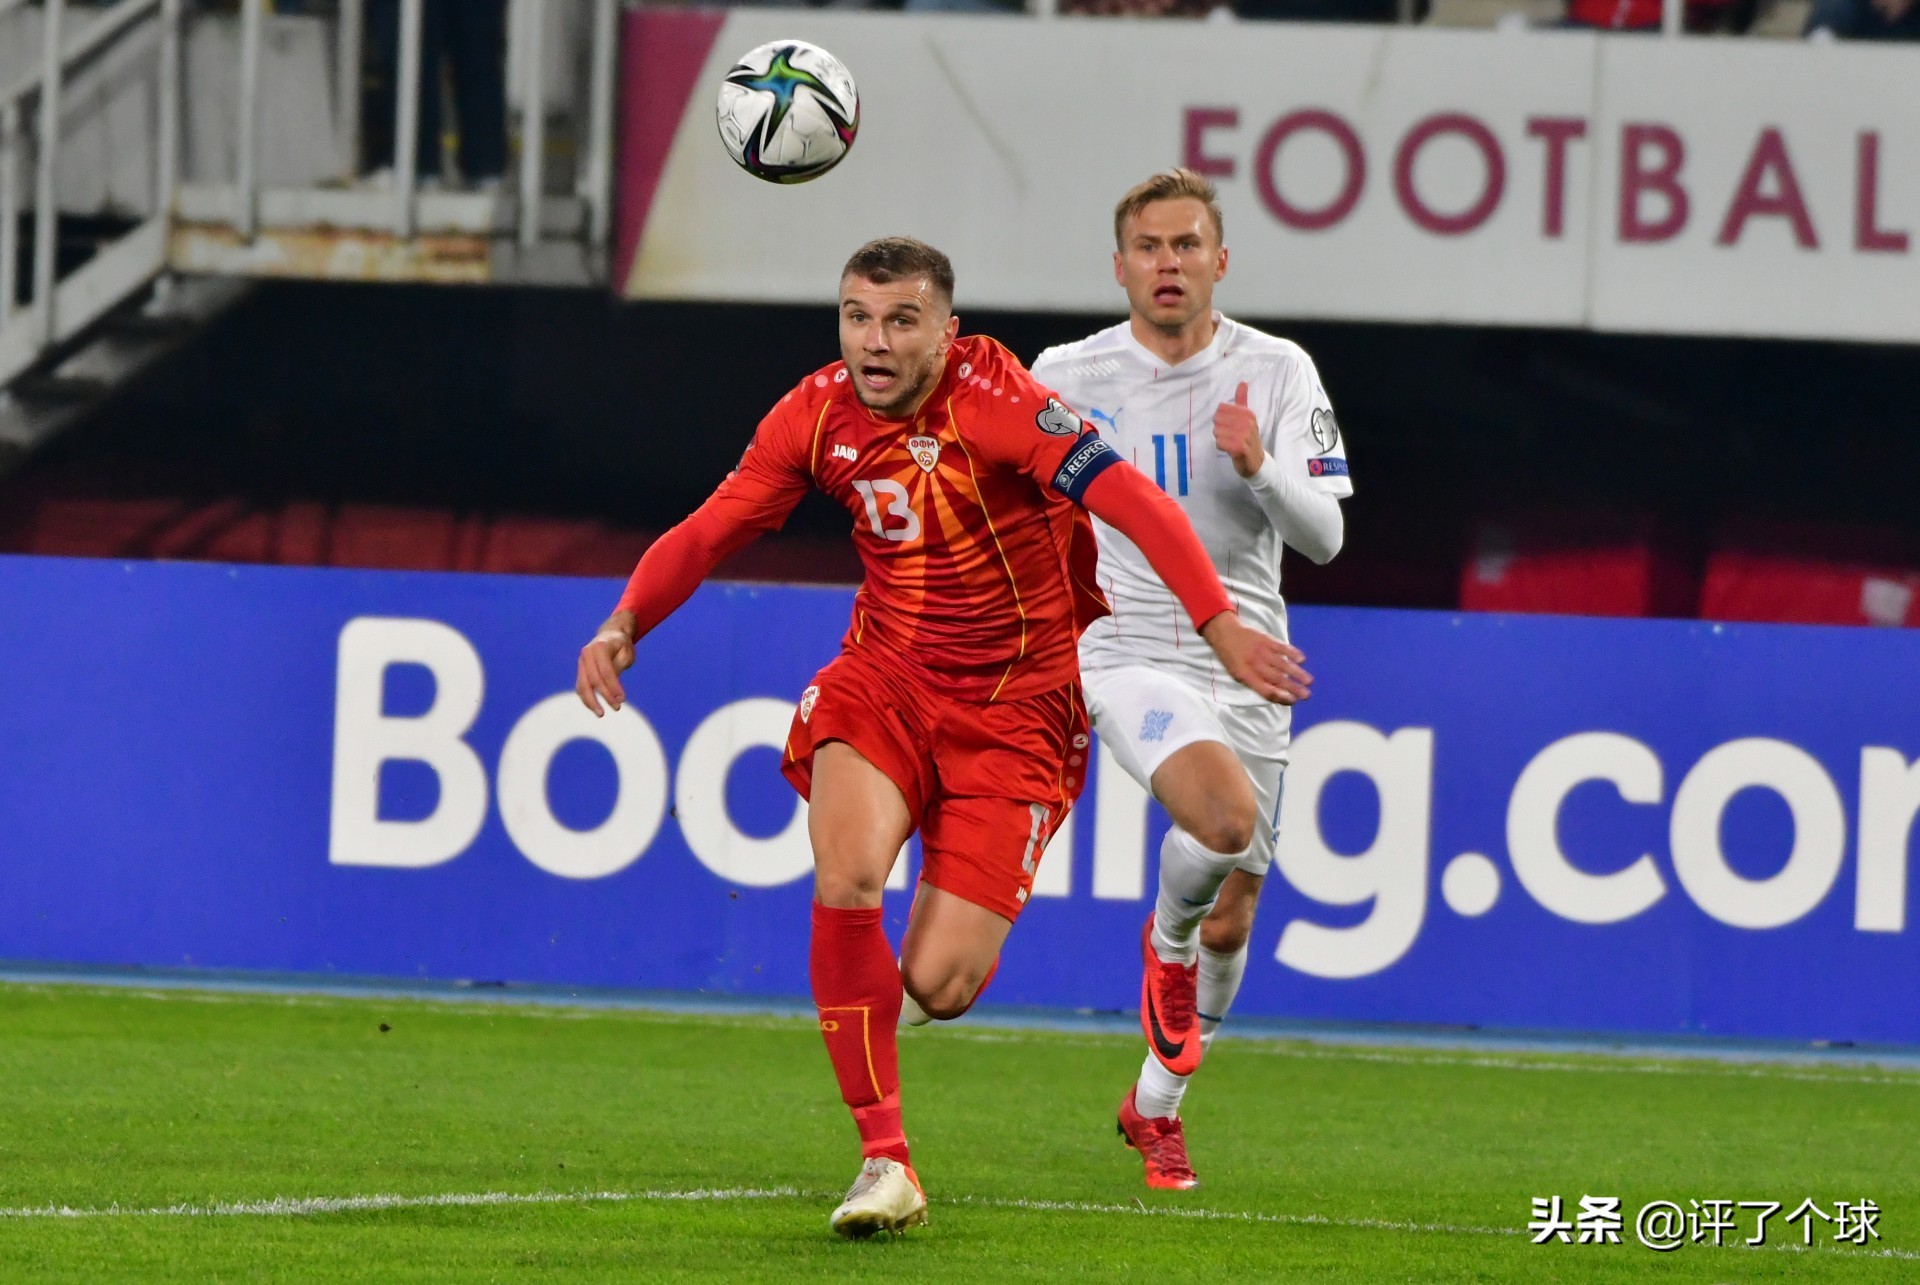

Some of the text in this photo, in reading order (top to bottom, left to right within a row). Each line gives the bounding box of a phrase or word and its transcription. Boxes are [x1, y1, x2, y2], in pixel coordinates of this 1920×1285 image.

[1182, 106, 1911, 254] FOOTBAL
[852, 479, 920, 541] 13
[1152, 434, 1188, 496] 11
[329, 616, 1920, 979] Boog.co
